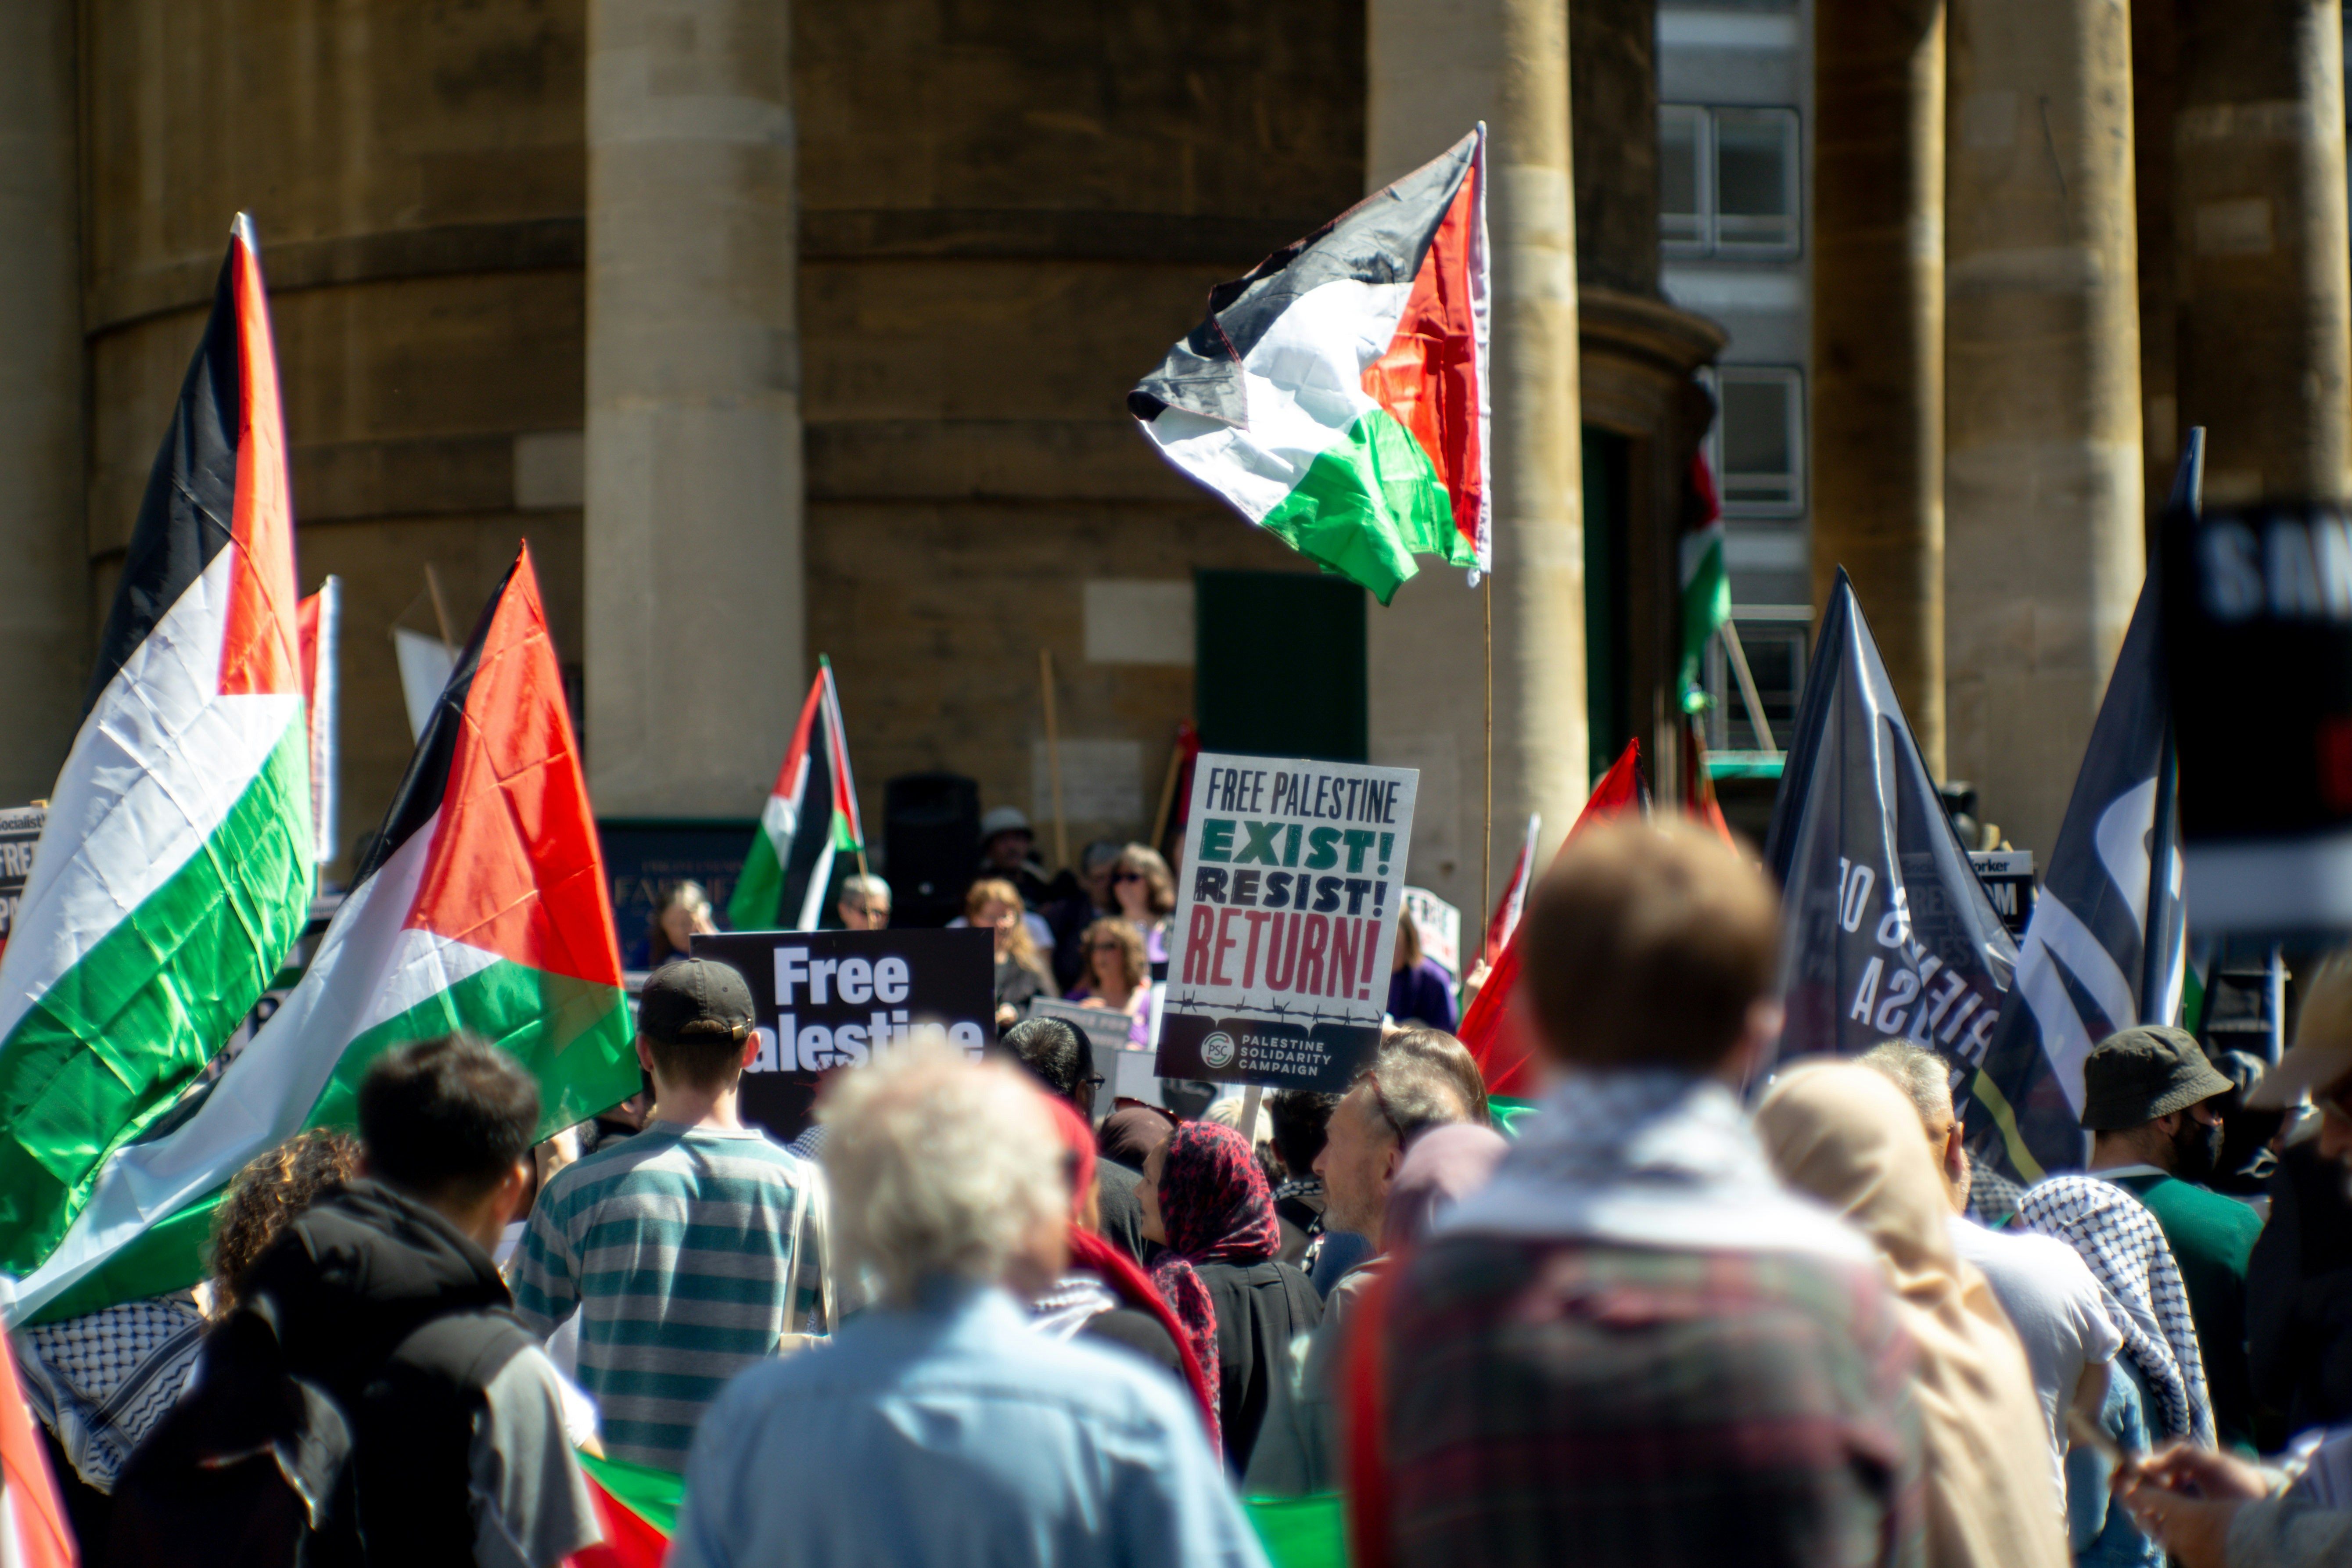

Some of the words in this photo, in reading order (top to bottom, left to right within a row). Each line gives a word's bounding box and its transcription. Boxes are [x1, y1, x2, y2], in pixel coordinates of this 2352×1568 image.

[1206, 768, 1267, 812] FREE
[1271, 771, 1400, 824] PALESTINE
[0, 814, 41, 831] ocialist
[1199, 818, 1395, 876] EXIST!
[1193, 866, 1388, 918] RESIST!
[1182, 904, 1381, 1001] RETURN!
[774, 947, 909, 1006] Free
[1208, 1044, 1228, 1056] PSC
[1240, 1047, 1332, 1065] SOLIDARITY
[1242, 1034, 1325, 1052] PALESTINE
[1239, 1059, 1318, 1076] CAMPAIGN
